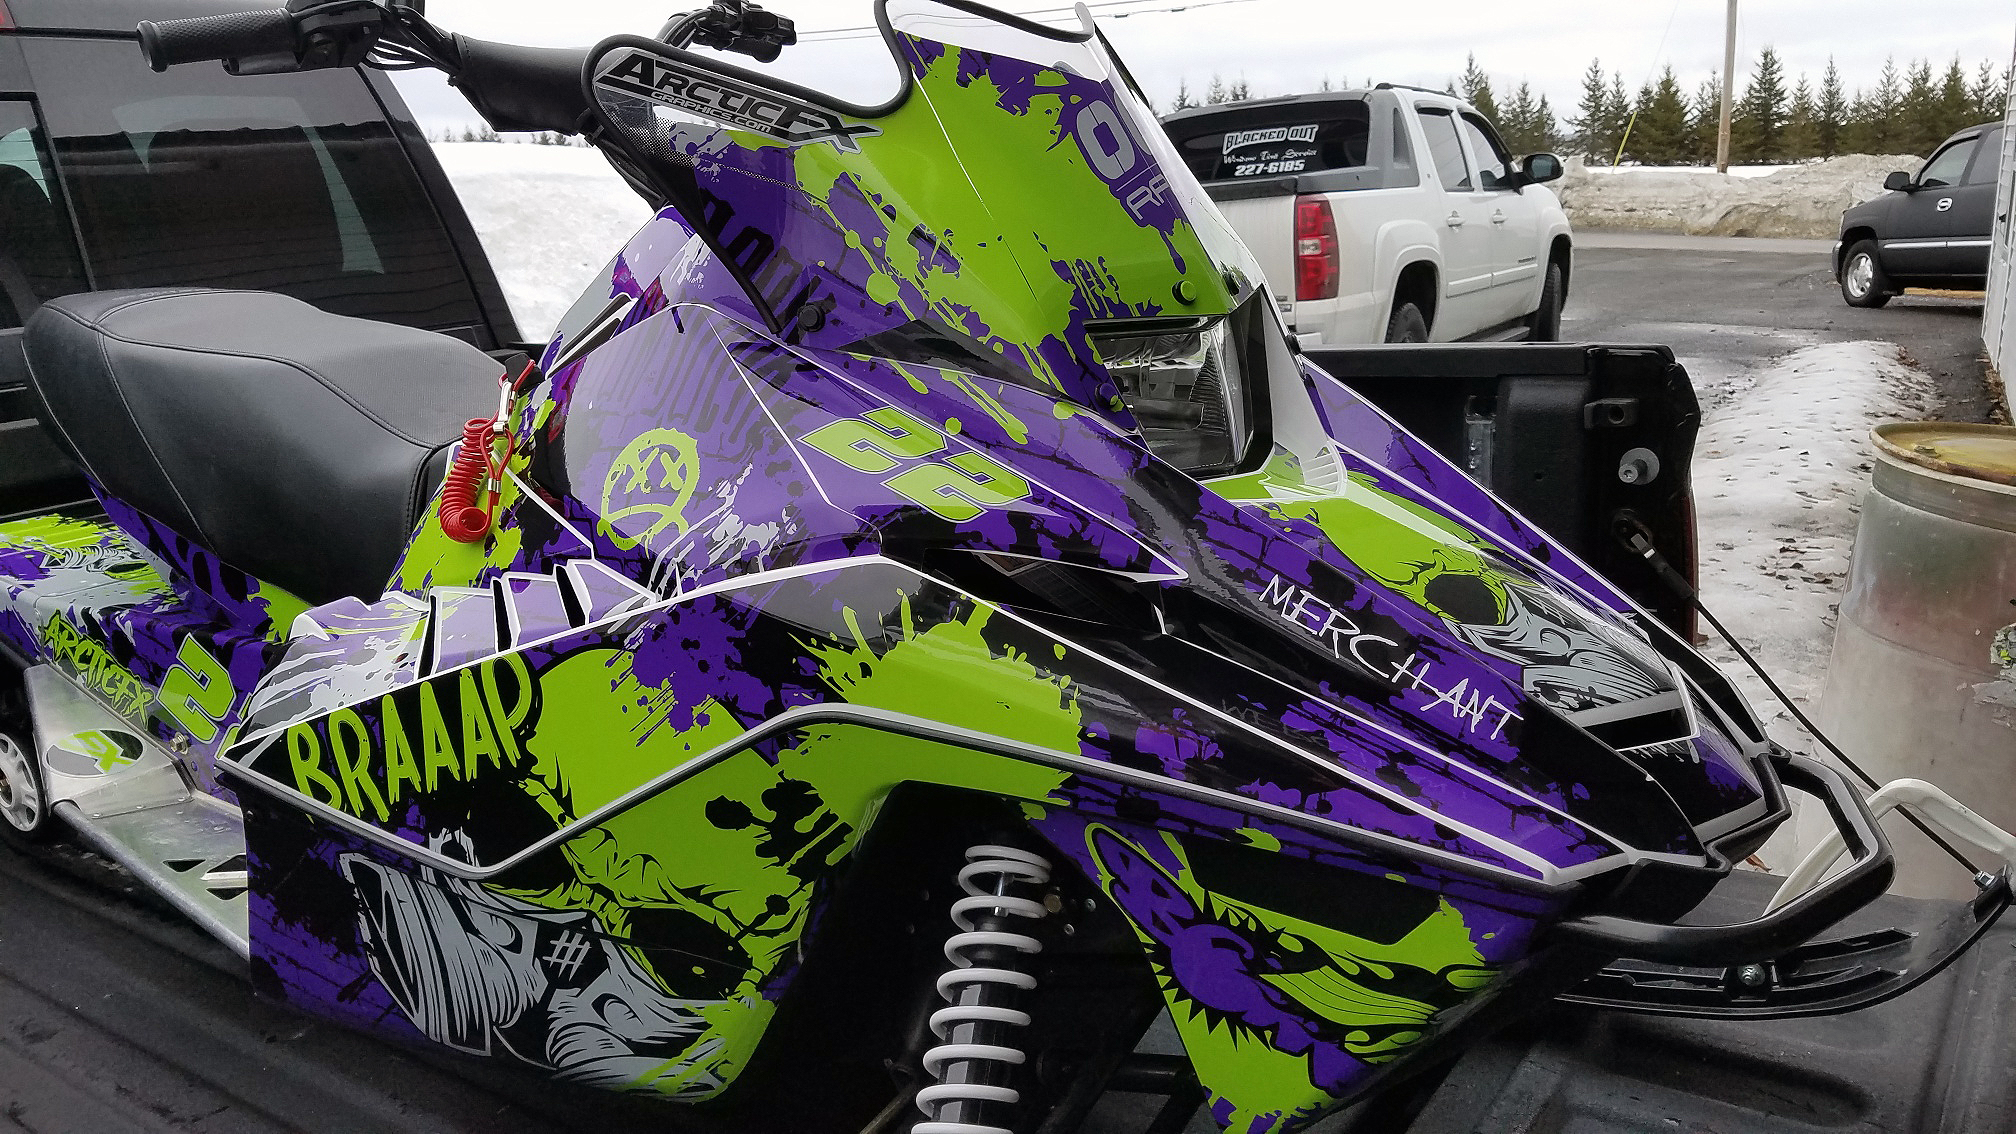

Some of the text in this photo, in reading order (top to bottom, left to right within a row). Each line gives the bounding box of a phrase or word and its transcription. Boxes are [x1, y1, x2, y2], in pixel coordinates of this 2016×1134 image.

[1222, 124, 1319, 154] BLACKED OUT
[1234, 159, 1306, 176] 227-6185
[1260, 151, 1278, 160] Tint
[1281, 148, 1317, 160] Service
[797, 405, 1034, 524] 22
[1259, 574, 1524, 740] MERCHANT
[286, 655, 533, 824] BRAAAP
